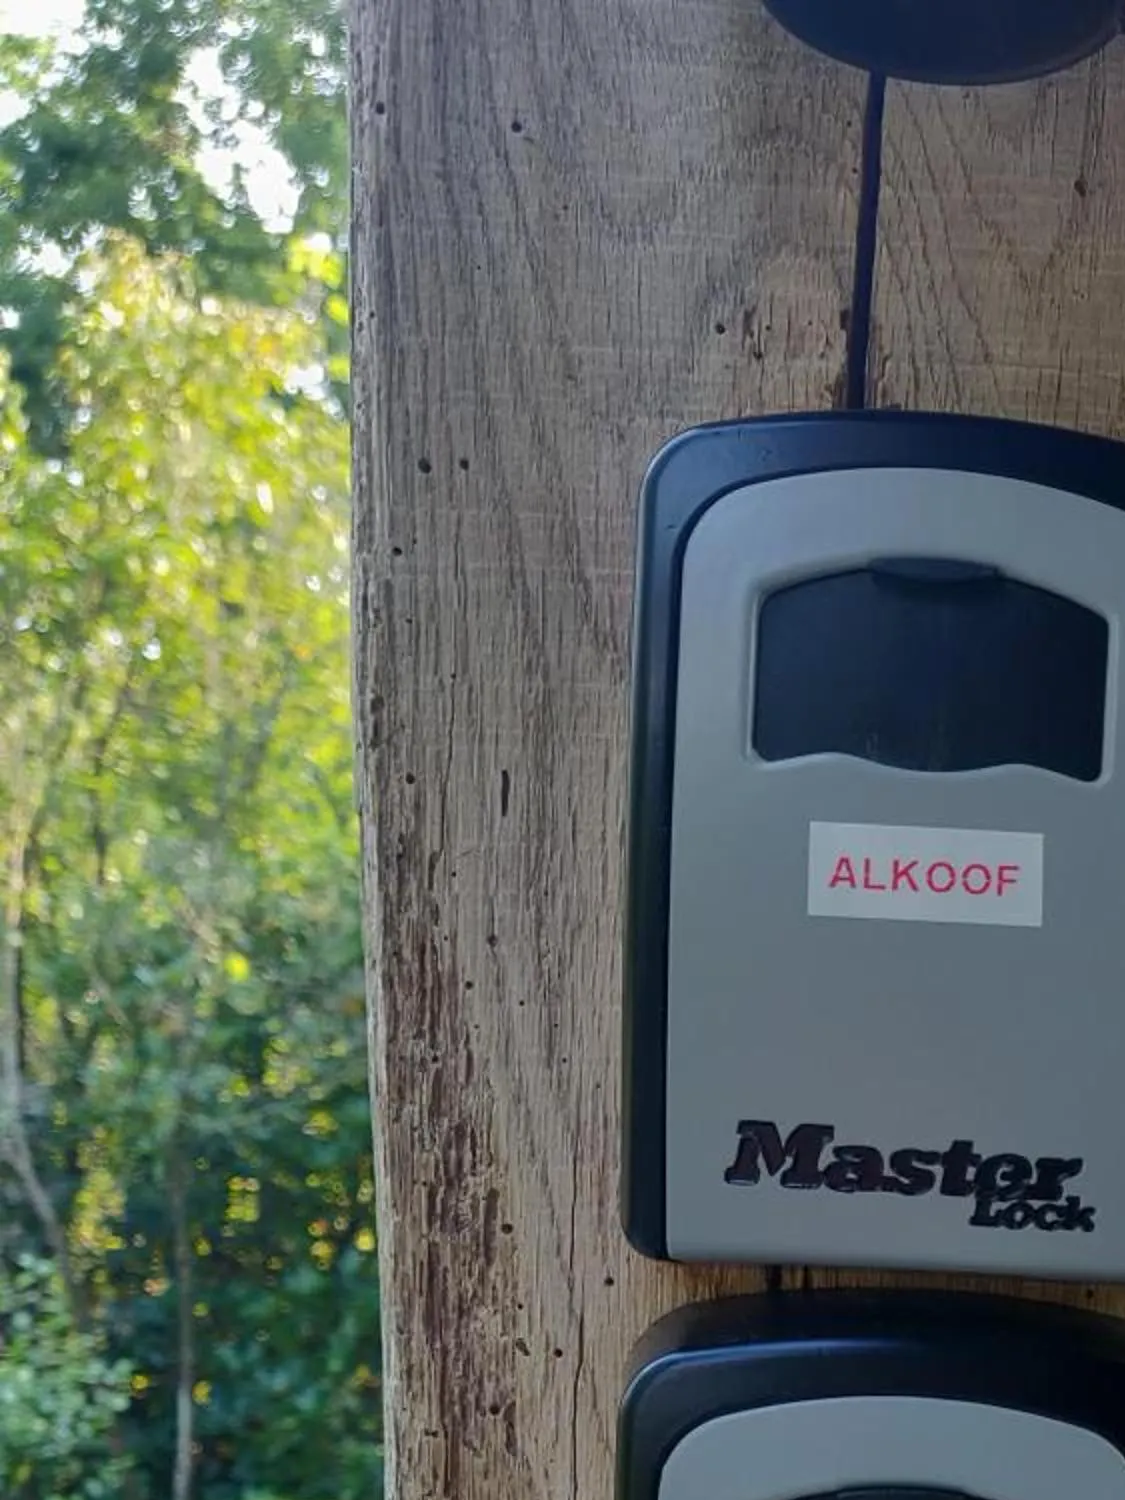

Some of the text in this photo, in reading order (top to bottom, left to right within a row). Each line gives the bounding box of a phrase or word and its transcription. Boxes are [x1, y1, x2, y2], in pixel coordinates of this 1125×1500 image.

[829, 856, 1021, 896] ALKOOF
[724, 1119, 1083, 1201] Master
[968, 1196, 1097, 1233] Lock
